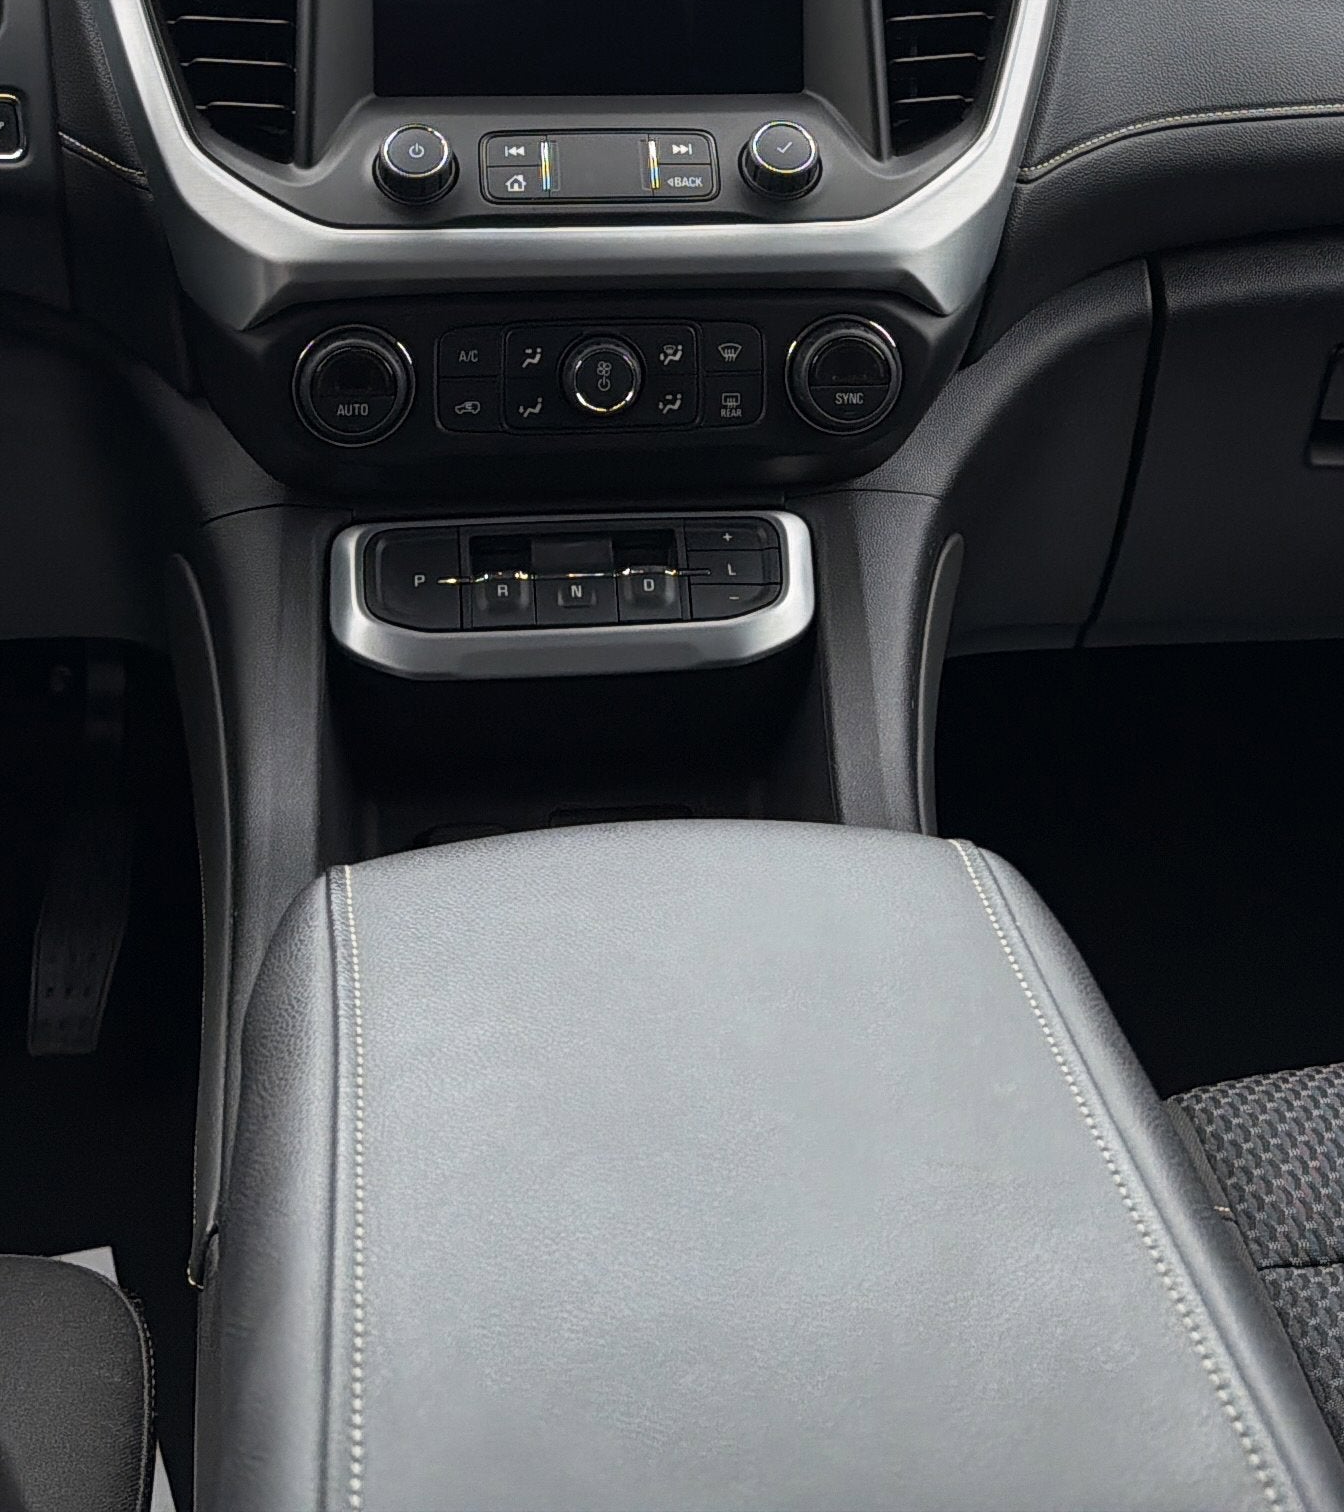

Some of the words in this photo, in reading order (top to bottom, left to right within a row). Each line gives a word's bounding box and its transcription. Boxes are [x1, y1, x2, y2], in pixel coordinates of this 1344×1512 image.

[673, 176, 704, 189] BACK
[458, 349, 480, 364] A/C
[834, 391, 865, 407] SYNC
[336, 401, 370, 418] AUTO
[720, 408, 743, 418] REAR
[727, 563, 737, 576] L
[414, 574, 426, 588] P
[643, 579, 655, 593] D
[497, 584, 509, 597] R
[570, 584, 583, 598] N
